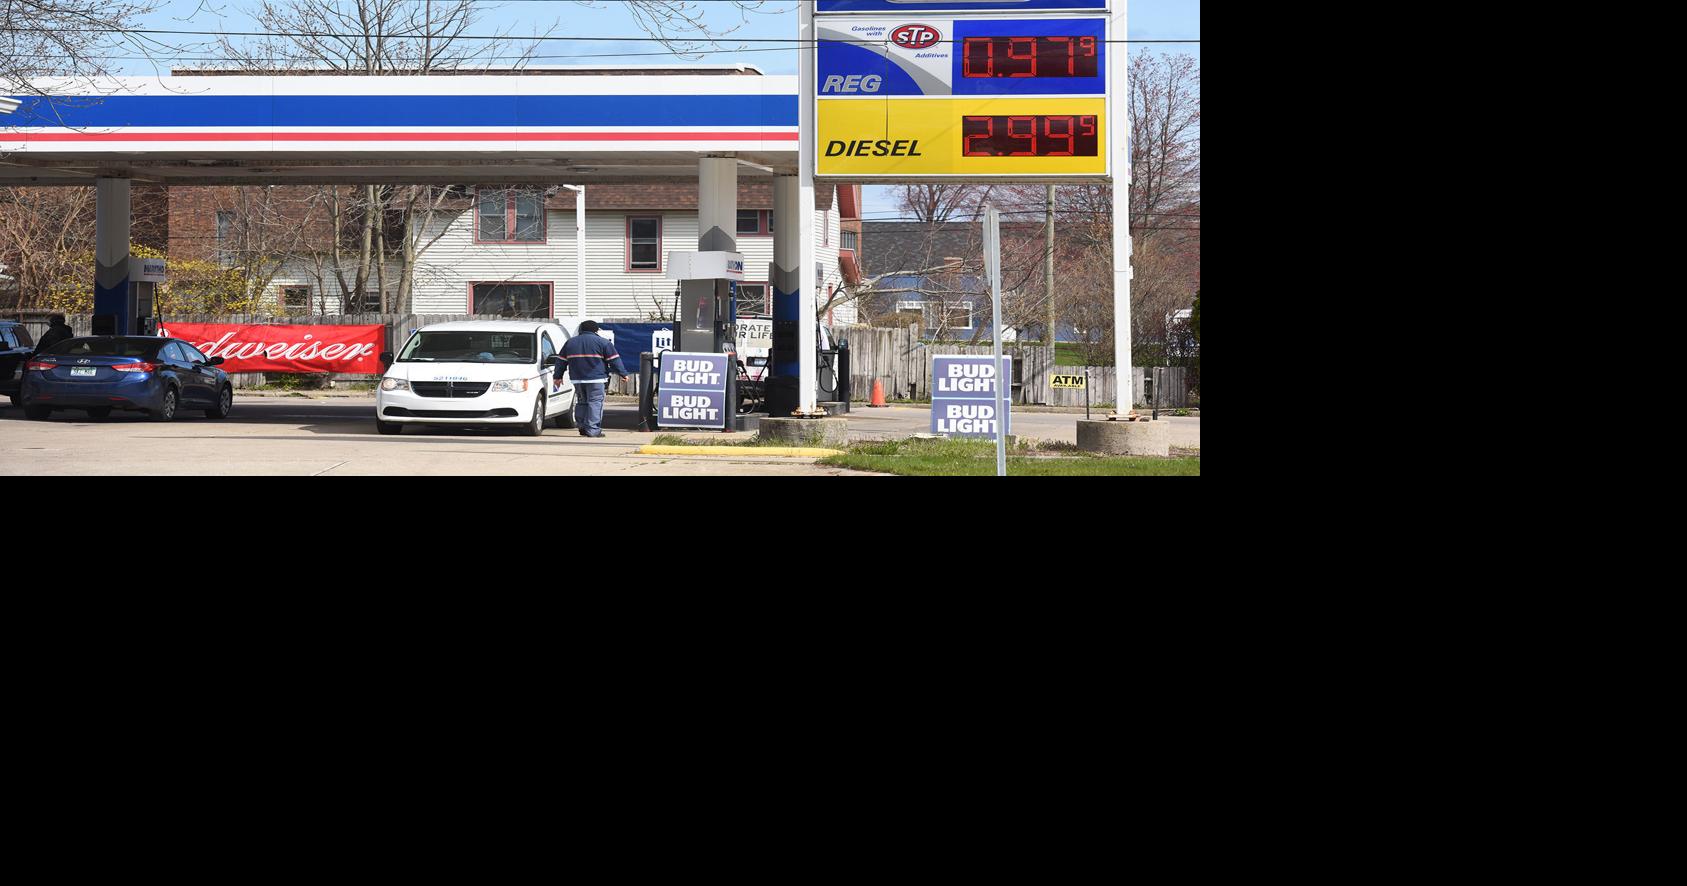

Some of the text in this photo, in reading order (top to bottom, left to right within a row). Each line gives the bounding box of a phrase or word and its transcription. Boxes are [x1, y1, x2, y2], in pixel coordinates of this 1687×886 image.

[897, 27, 934, 45] STP
[822, 74, 882, 93] REG
[825, 140, 922, 157] DIESEL
[157, 328, 376, 361] dweiser
[673, 360, 714, 372] BUD
[948, 364, 995, 378] BUD
[664, 371, 721, 385] LIGHT
[1053, 375, 1084, 385] ATM
[671, 395, 712, 408] BUD
[662, 407, 719, 420] LIGHT
[947, 405, 994, 419] BUD
